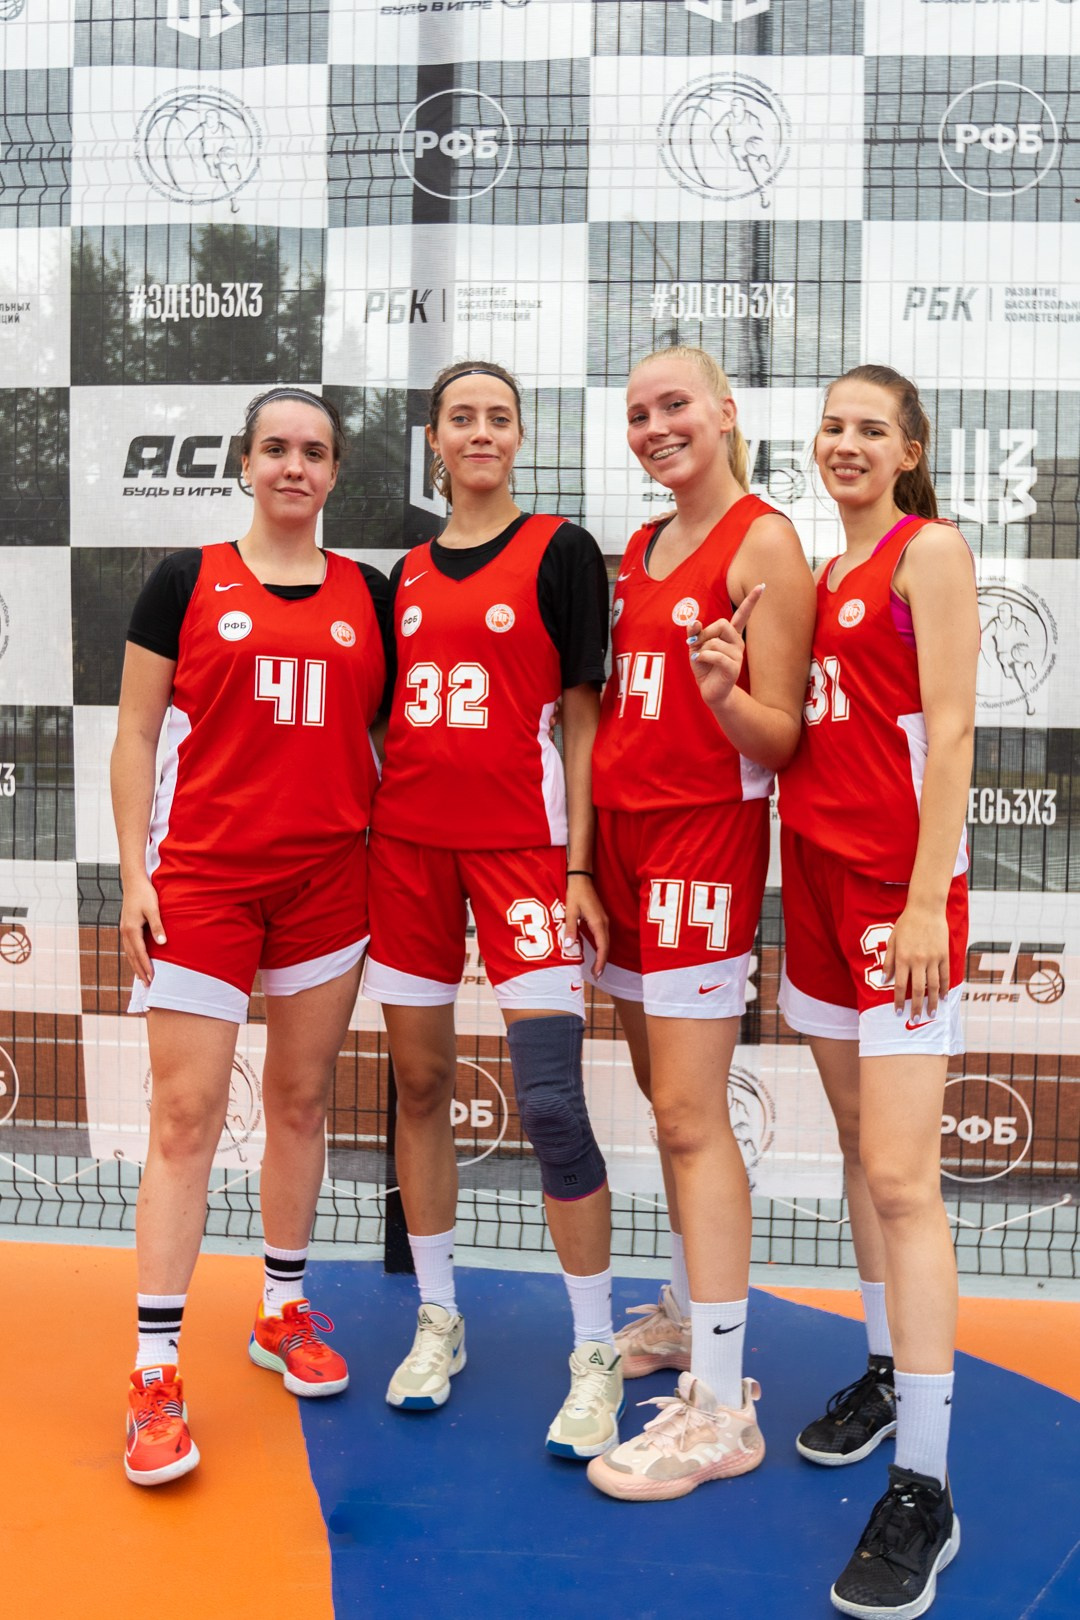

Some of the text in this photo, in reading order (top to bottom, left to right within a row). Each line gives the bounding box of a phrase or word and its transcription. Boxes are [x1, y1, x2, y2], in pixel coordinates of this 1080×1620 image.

[431, 1, 443, 12] В
[415, 130, 499, 159] РФБ
[955, 123, 1043, 154] РФБ
[364, 289, 432, 324] РБК
[903, 287, 979, 321] РБК
[1004, 287, 1057, 297] РАЗВИТИЕ
[122, 487, 233, 498] БУДЬ В ИГРЕ
[223, 621, 248, 631] РФБ
[255, 655, 327, 727] 41
[405, 661, 490, 729] 32
[803, 656, 850, 726] 31
[647, 878, 732, 951] 44
[860, 922, 896, 990] 3
[972, 993, 1020, 1003] ИГРЕ
